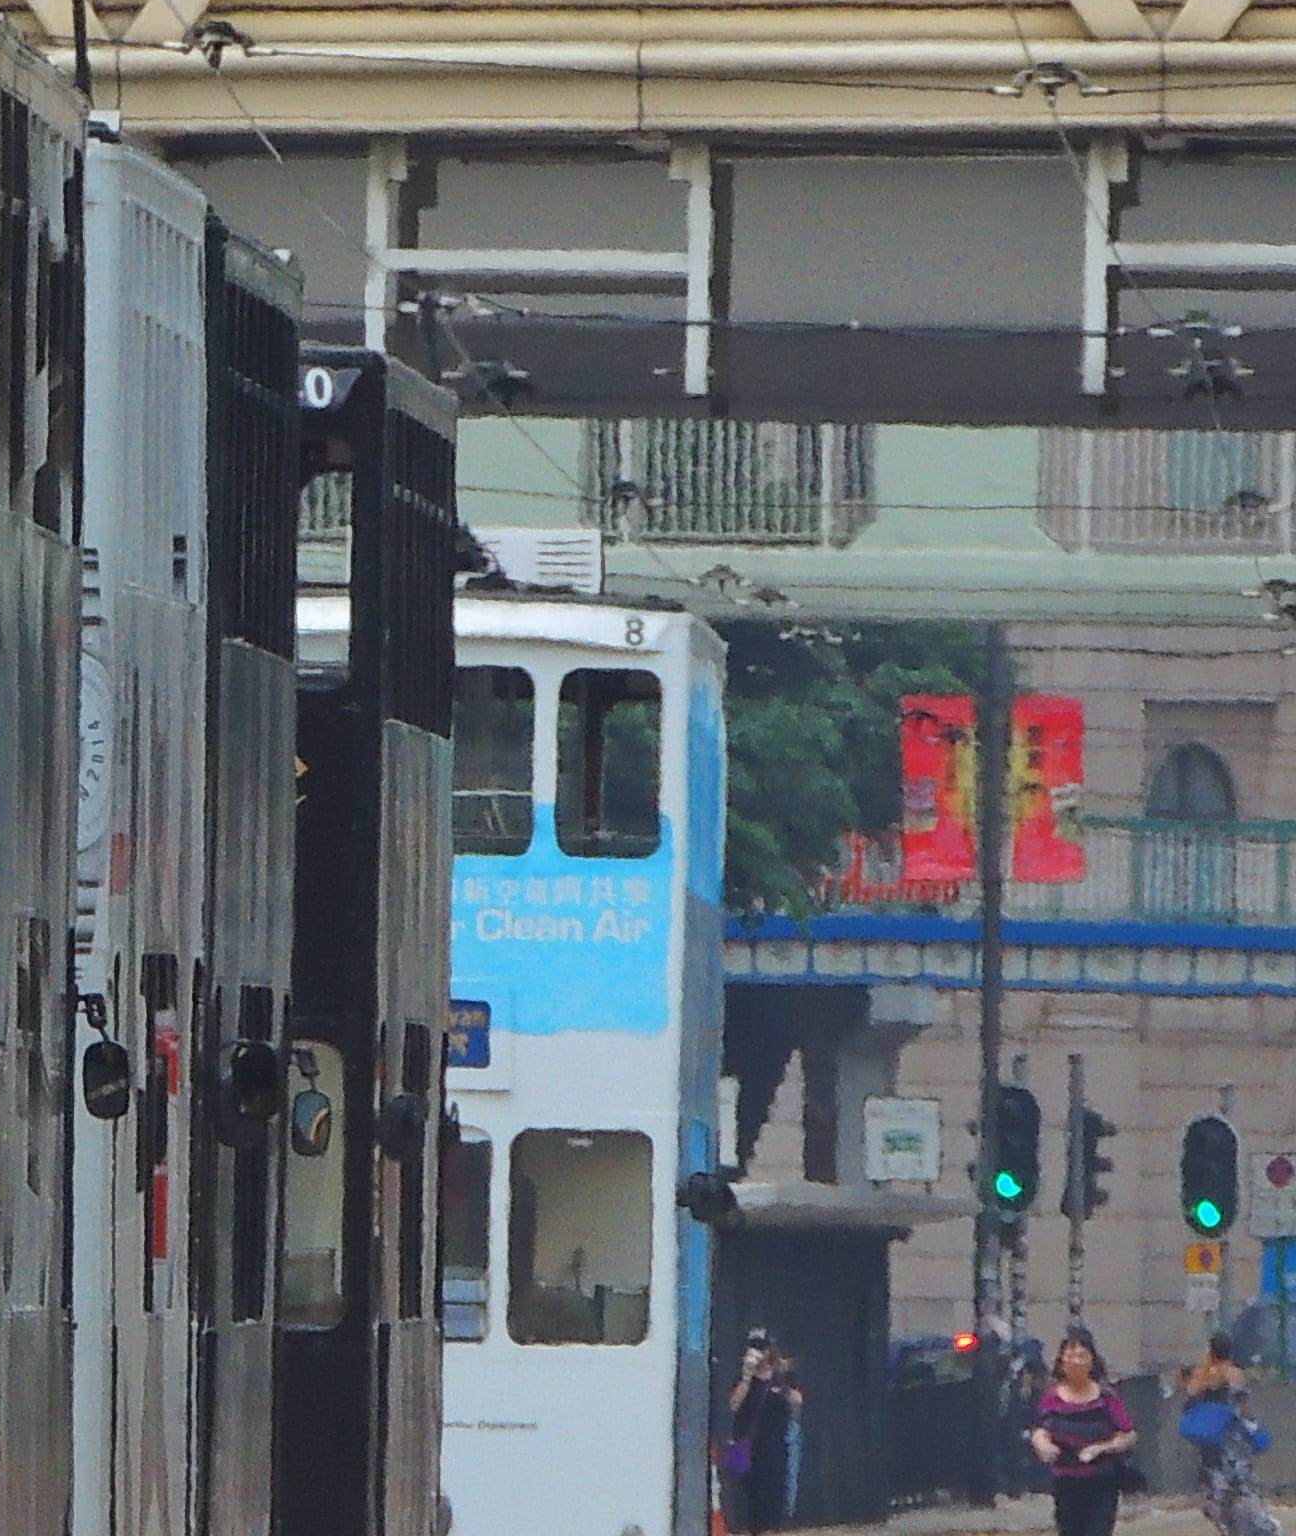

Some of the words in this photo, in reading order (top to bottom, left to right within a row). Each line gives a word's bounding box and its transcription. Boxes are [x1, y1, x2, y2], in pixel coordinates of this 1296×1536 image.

[625, 615, 644, 646] 8
[476, 907, 585, 942] Clean
[592, 908, 651, 943] Air
